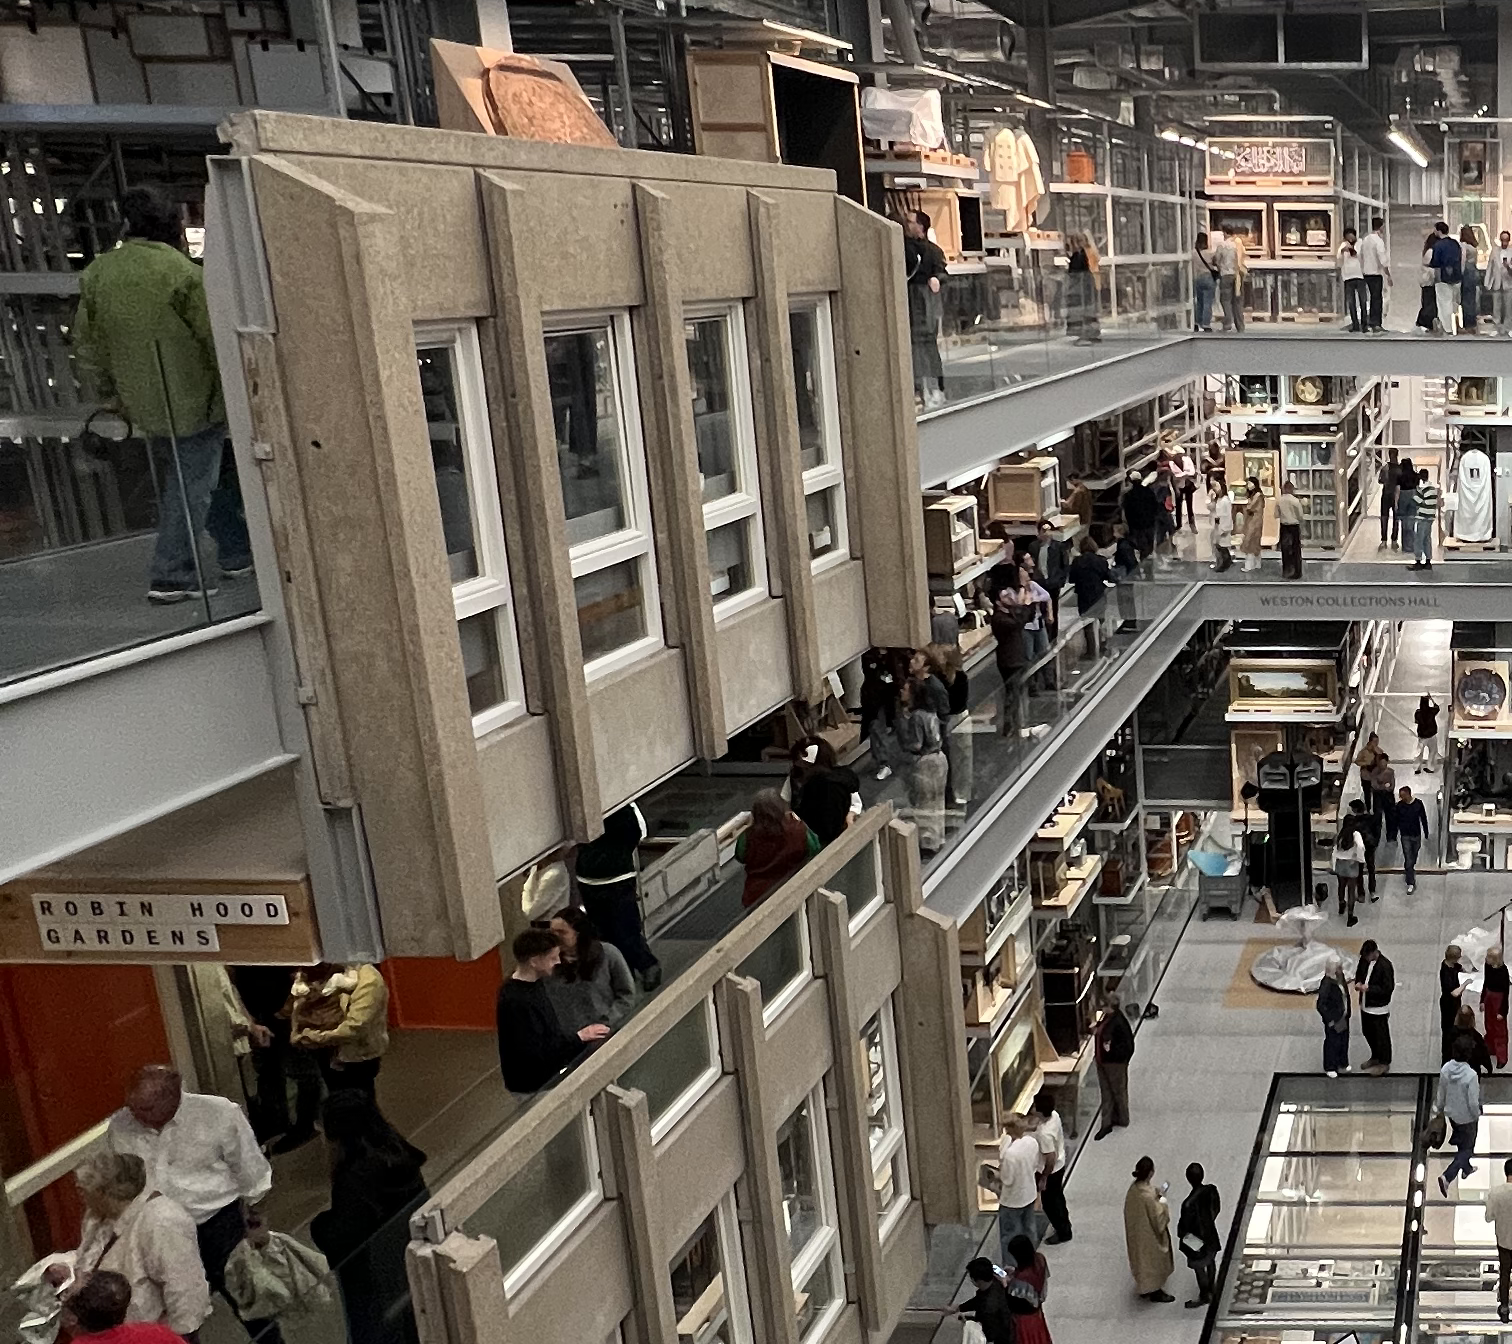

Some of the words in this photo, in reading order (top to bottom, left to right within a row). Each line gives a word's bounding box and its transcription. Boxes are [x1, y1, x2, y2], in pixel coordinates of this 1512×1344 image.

[1259, 596, 1314, 607] WESTON
[1316, 596, 1406, 607] COLLECTIONS
[1407, 596, 1441, 607] HALL
[38, 900, 154, 917] ROBIN
[190, 901, 280, 918] HOOD
[46, 928, 211, 946] GARDENS
